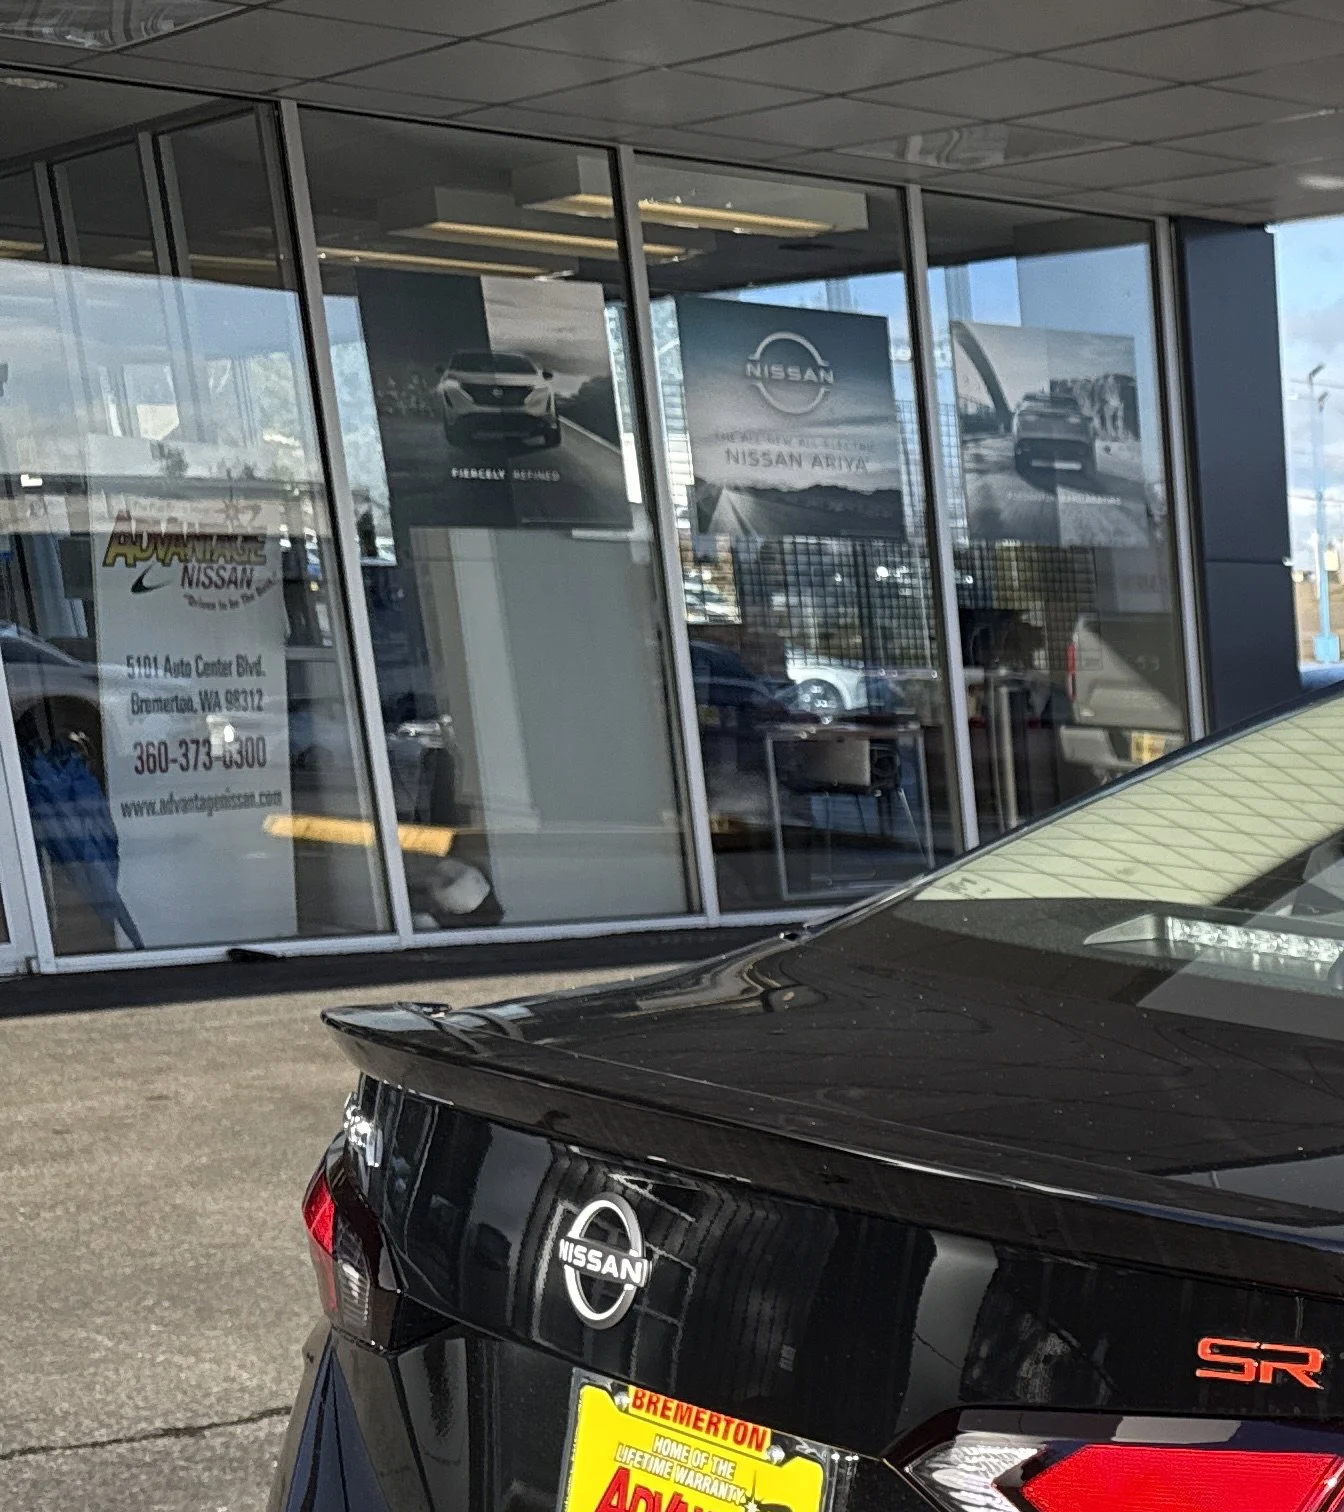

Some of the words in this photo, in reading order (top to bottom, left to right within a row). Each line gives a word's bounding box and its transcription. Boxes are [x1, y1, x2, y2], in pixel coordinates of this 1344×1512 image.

[746, 363, 834, 384] NISSAN
[451, 467, 505, 481] FIERCELY
[726, 448, 803, 469] NISSAN
[811, 453, 868, 474] ARIYA
[102, 509, 268, 568] ADVANTAGE
[181, 564, 255, 590] NISSAN
[126, 655, 159, 679] 5101
[164, 654, 192, 678] Auto
[195, 654, 233, 678] Center
[236, 653, 266, 678] Blvd.
[131, 690, 198, 716] Bremerton,
[199, 689, 222, 713] WA
[559, 1238, 643, 1284] NISSAN
[1196, 1337, 1325, 1390] SR
[631, 1386, 768, 1453] BREMERTON
[614, 1442, 675, 1481] LIFETIME
[652, 1433, 691, 1464] HOME
[690, 1444, 710, 1471] OF
[710, 1454, 737, 1481] THE
